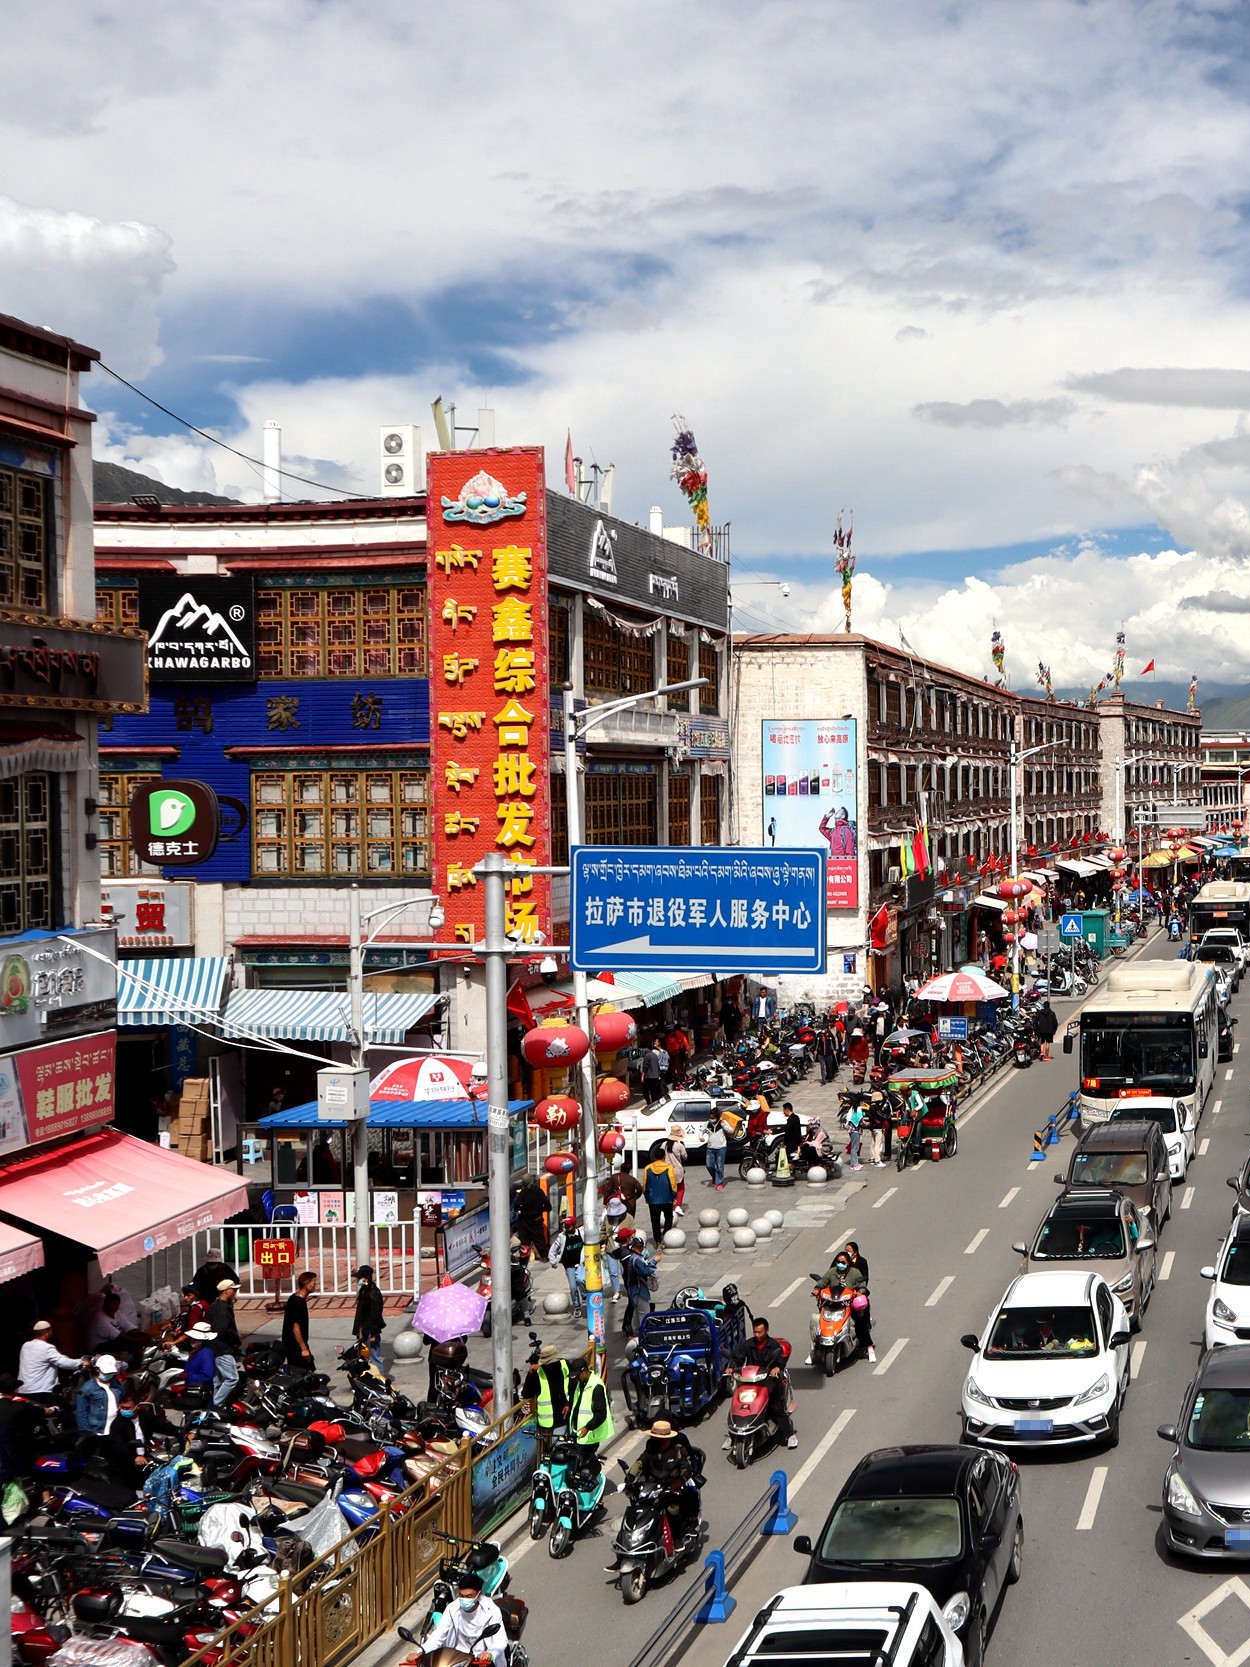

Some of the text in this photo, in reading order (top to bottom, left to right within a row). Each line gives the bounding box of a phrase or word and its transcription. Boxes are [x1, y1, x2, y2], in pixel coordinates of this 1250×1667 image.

[490, 544, 539, 945] 赛鑫综合批发市场
[147, 840, 199, 857] 德克士
[827, 875, 852, 884] 有限公司
[585, 896, 812, 930] 拉萨市退役军人服务中心
[35, 1071, 112, 1121] 鞋服批发
[545, 1104, 567, 1126] 勒
[260, 1251, 290, 1265] 出口
